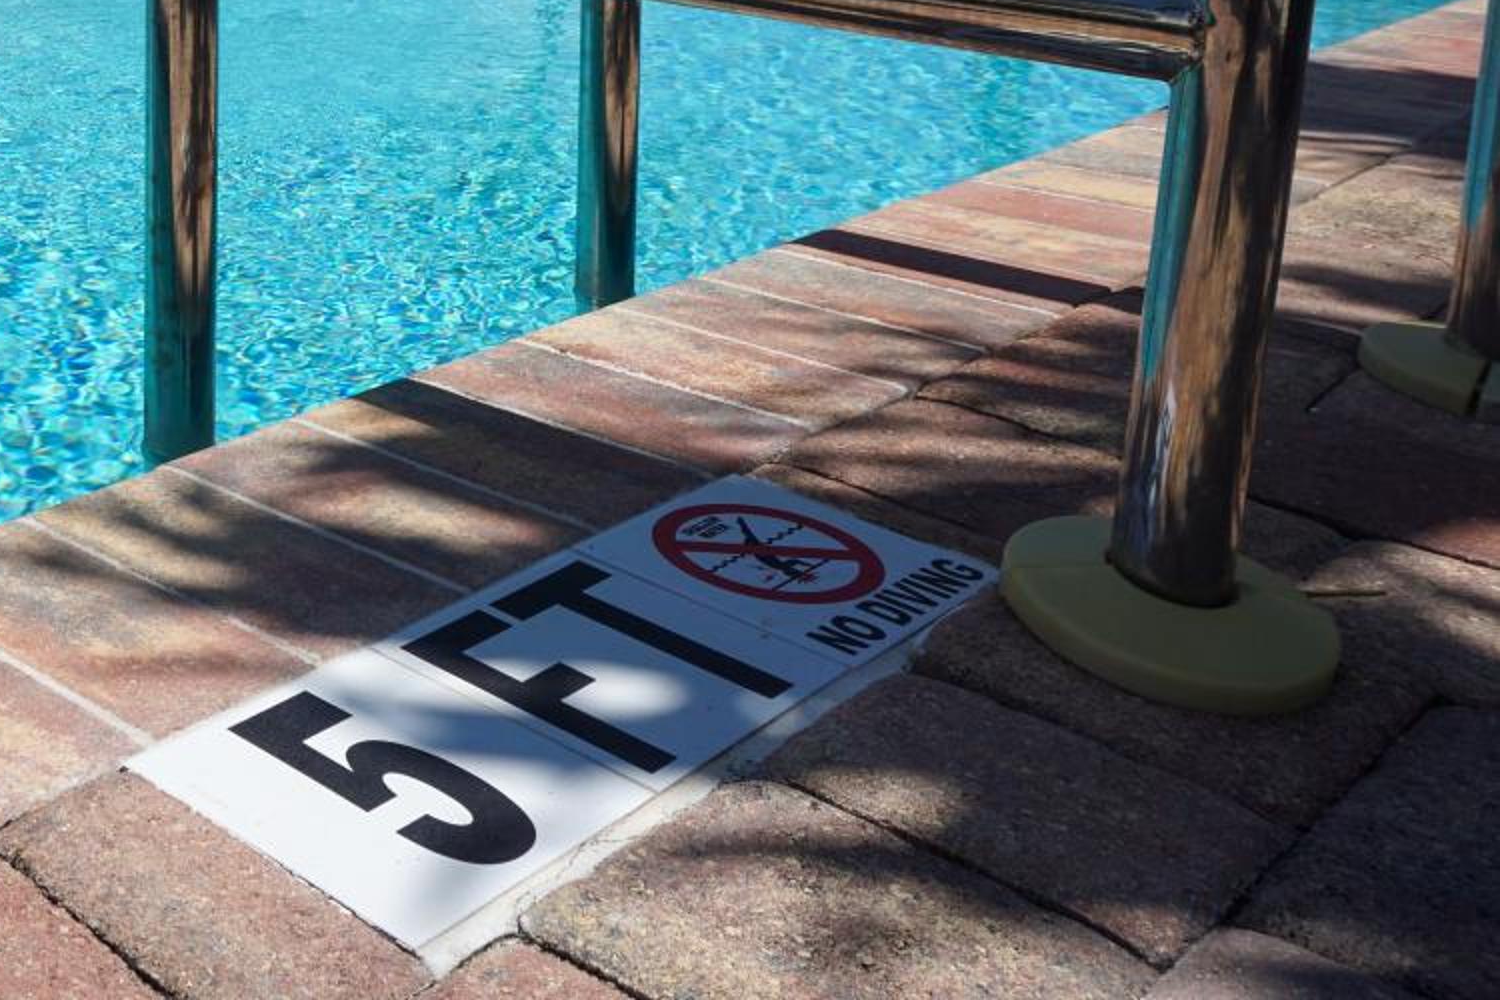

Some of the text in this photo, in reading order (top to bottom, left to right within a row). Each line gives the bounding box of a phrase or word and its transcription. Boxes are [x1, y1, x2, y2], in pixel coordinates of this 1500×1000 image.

[805, 558, 985, 656] NO DIVING
[228, 559, 794, 866] 5 FT
